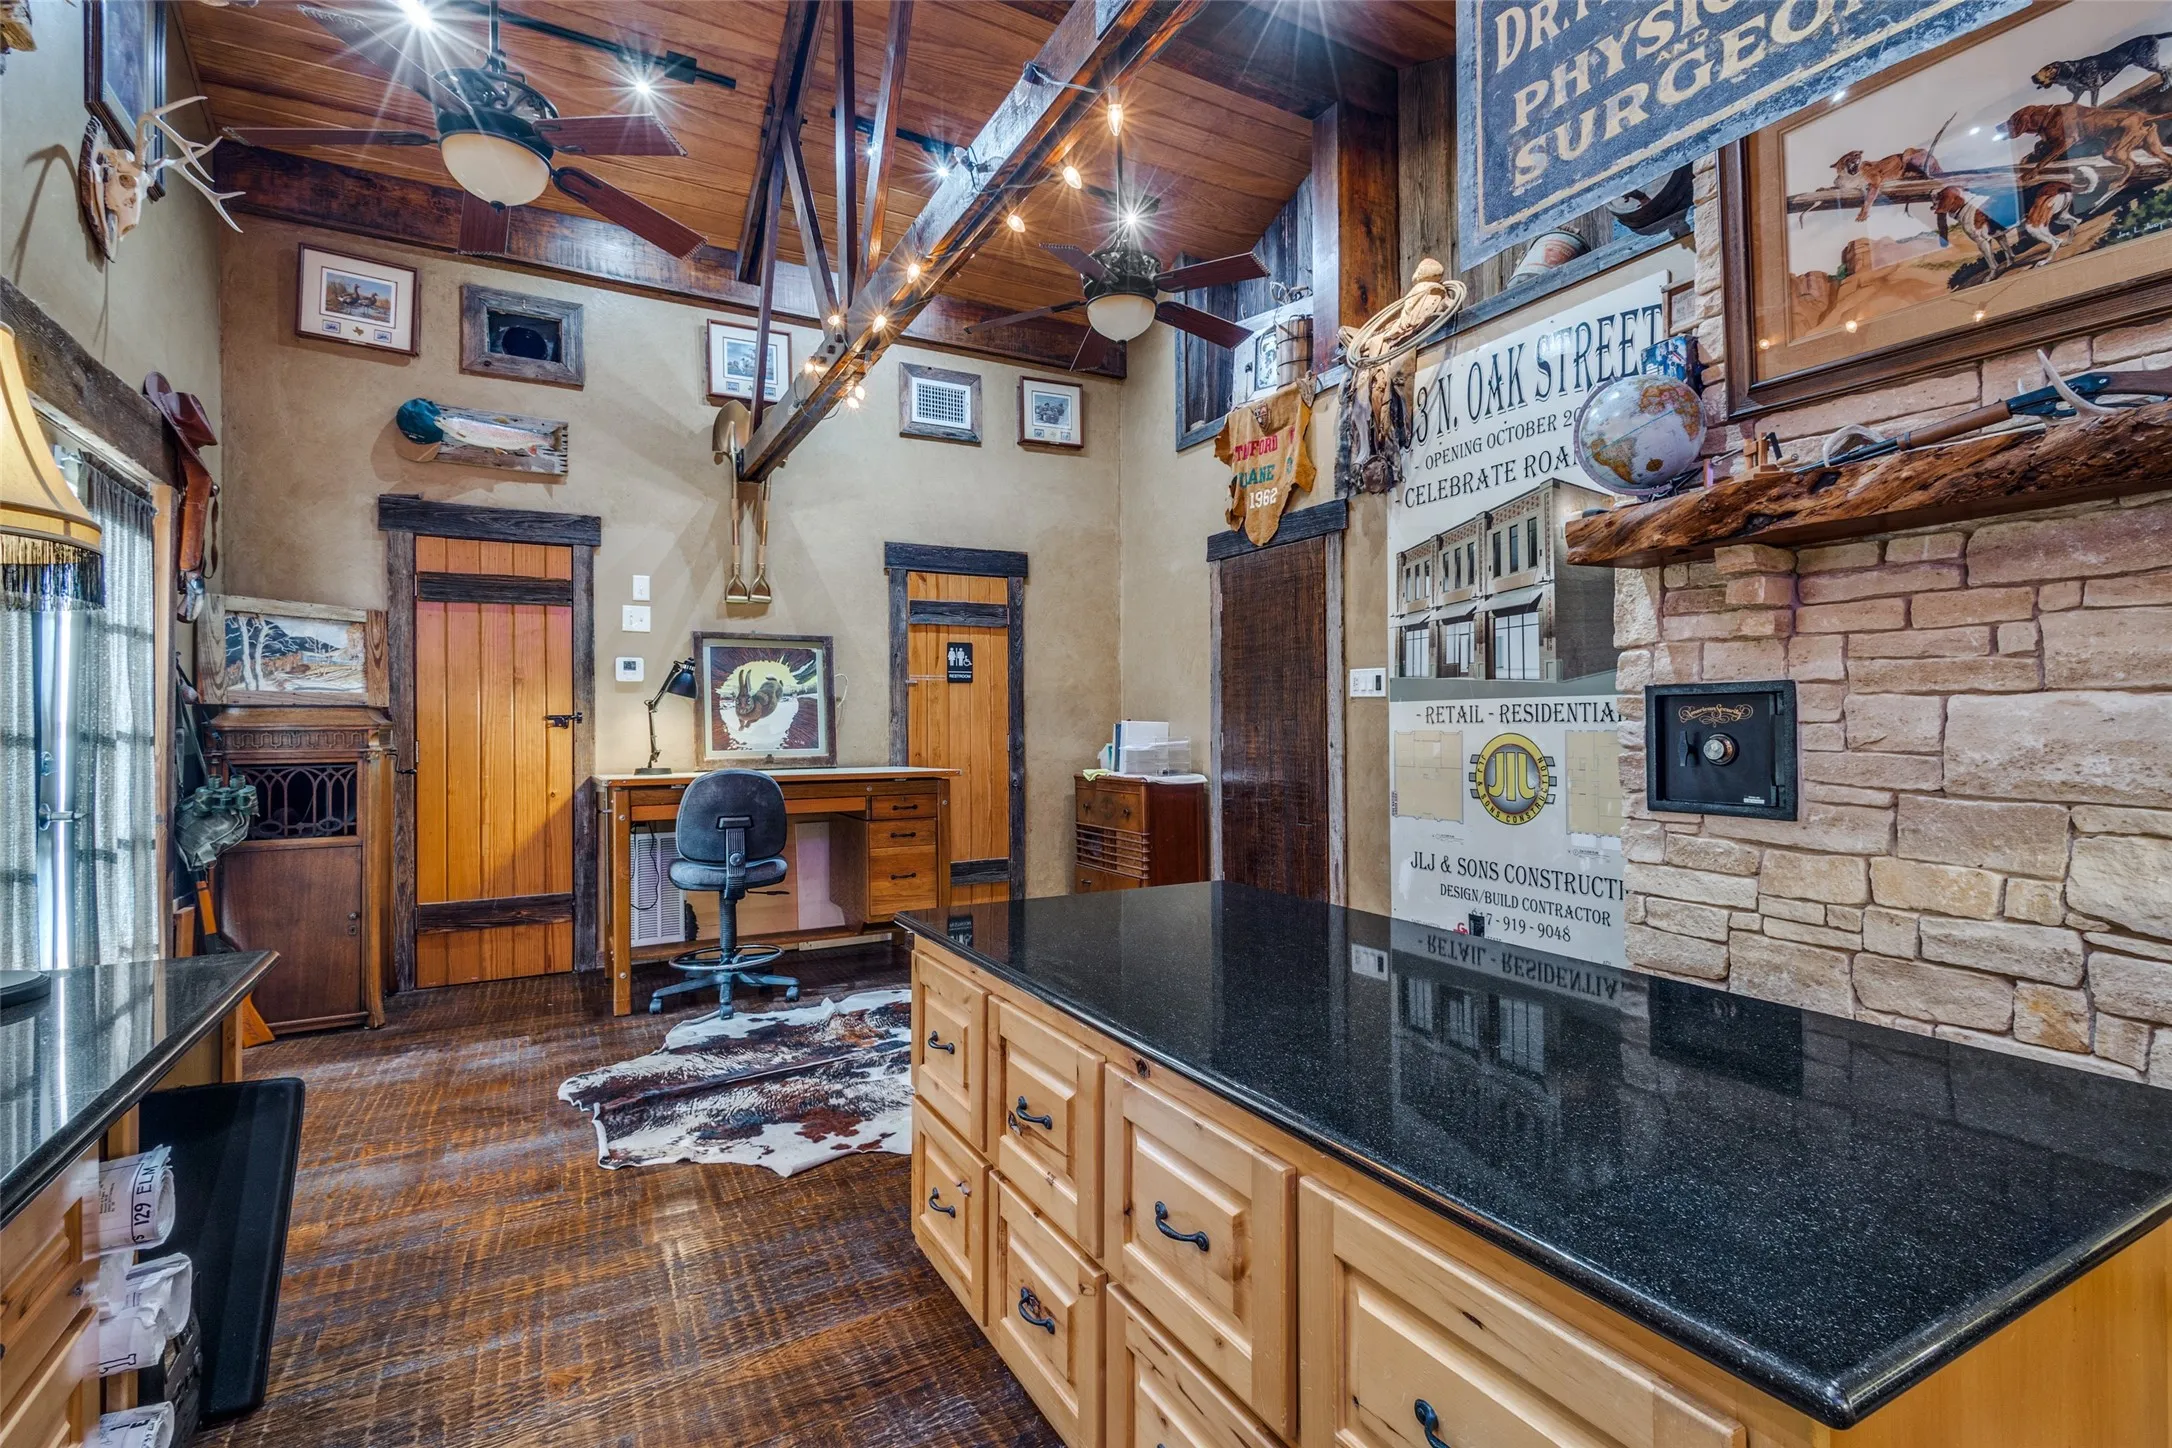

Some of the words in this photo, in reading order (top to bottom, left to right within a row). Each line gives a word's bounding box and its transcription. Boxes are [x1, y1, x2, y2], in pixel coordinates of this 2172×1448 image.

[1511, 0, 1740, 133] PHYSI
[1655, 28, 1709, 66] AND
[1512, 0, 1864, 195] SURGEO
[1437, 373, 1458, 437] N.
[1467, 343, 1527, 423] OAK
[1535, 304, 1662, 400] STREET
[1425, 437, 1483, 470] OPENING
[1486, 414, 1557, 449] OCTOBER
[1249, 487, 1278, 509] 1962
[1405, 459, 1517, 509] CELEBRATE
[1524, 446, 1578, 479] ROA
[1425, 704, 1484, 724] RETAIL
[1499, 702, 1628, 724] RESIDENTIA
[1481, 793, 1501, 818] SONS
[1505, 756, 1548, 824] CONSTRUCTION
[1411, 851, 1435, 871] JLJ
[1440, 855, 1452, 874] &
[1457, 857, 1500, 881] SONS
[1504, 863, 1629, 900] CONSTRUCTI
[1440, 883, 1519, 909] DESIGN/BUILD
[1522, 897, 1611, 927] CONTRACTOR
[1503, 915, 1526, 934] 919
[1537, 923, 1571, 943] 9048
[136, 1164, 159, 1195] ELM
[133, 1202, 152, 1226] 129
